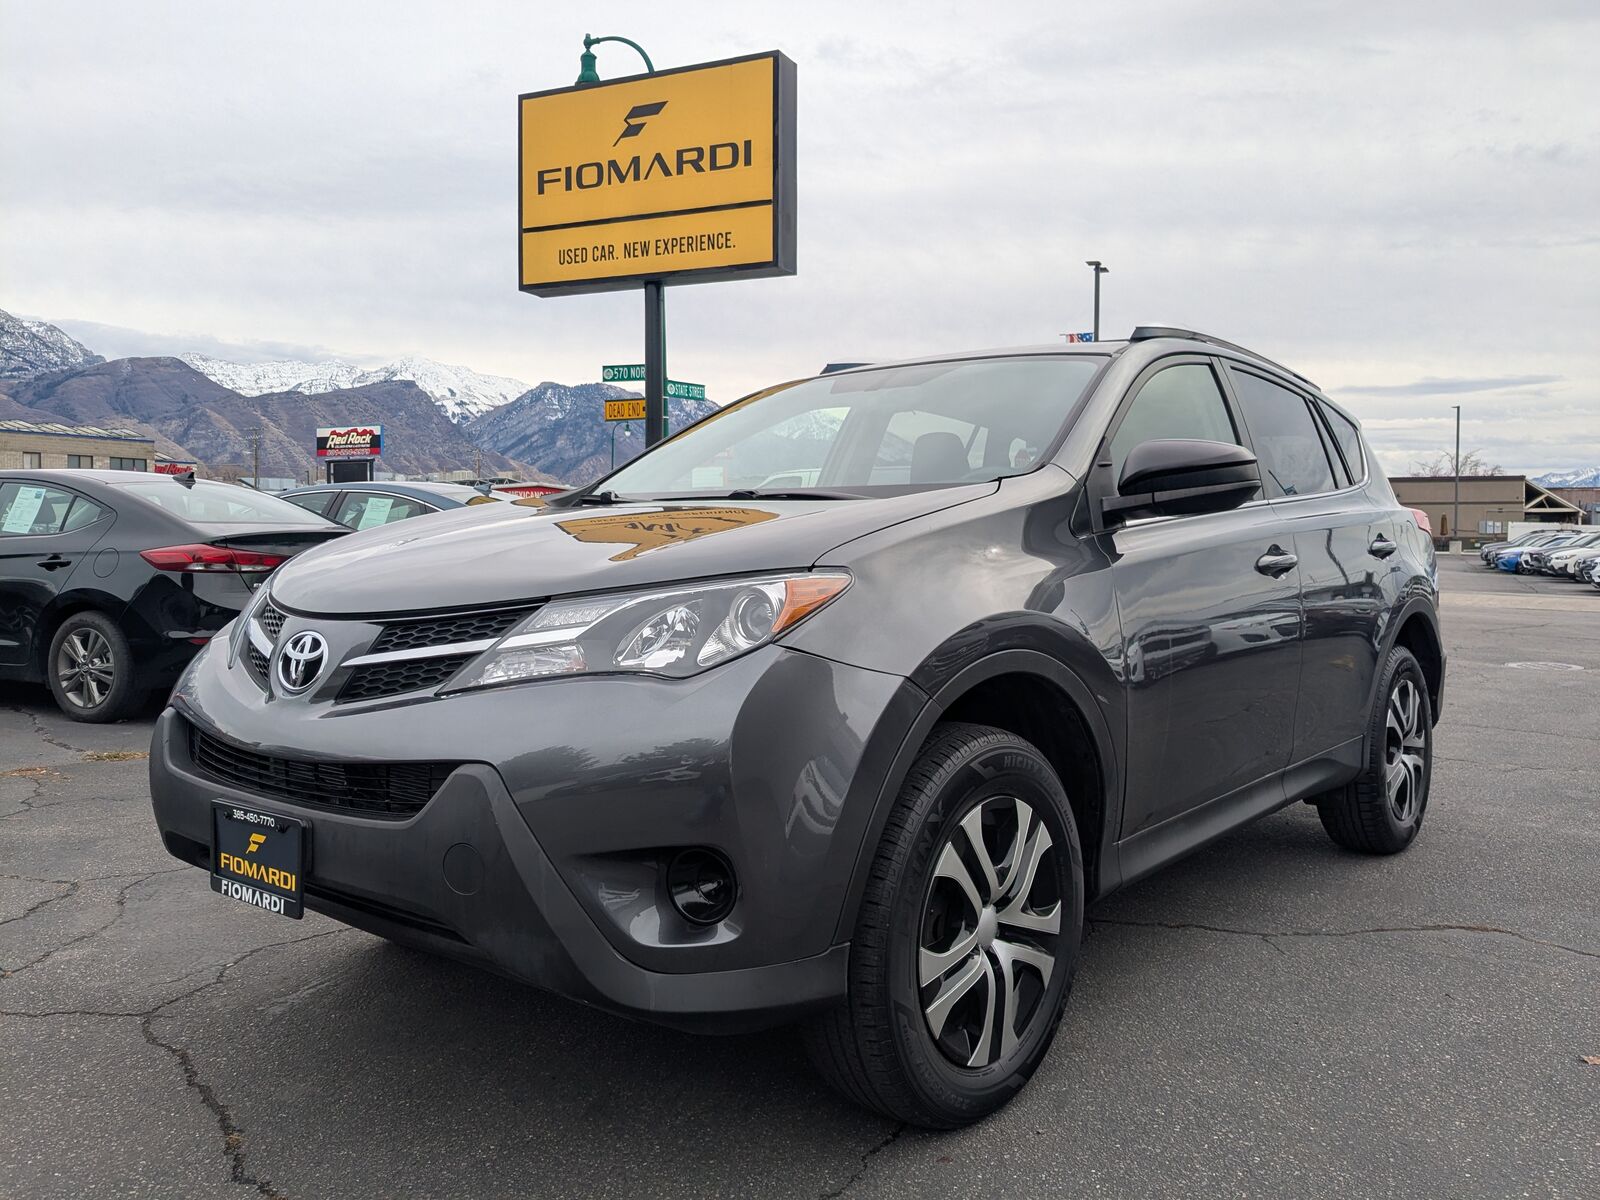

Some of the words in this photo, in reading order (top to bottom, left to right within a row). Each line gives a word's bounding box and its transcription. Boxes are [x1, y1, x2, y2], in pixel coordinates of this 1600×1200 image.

[537, 140, 752, 195] FIOMARDI
[558, 247, 588, 266] USED
[592, 244, 619, 262] CAR.
[623, 240, 651, 259] NEW
[655, 231, 736, 257] EXPERIENCE.
[614, 367, 628, 379] 570
[675, 383, 688, 397] STATE
[688, 385, 704, 398] STREET
[608, 403, 624, 418] DEAD
[628, 402, 640, 417] END
[326, 434, 349, 448] Red
[347, 432, 373, 444] Rock
[233, 809, 275, 827] 385-450-7770
[220, 852, 296, 892] FIOMARDI
[221, 879, 285, 914] FIOMARDI
